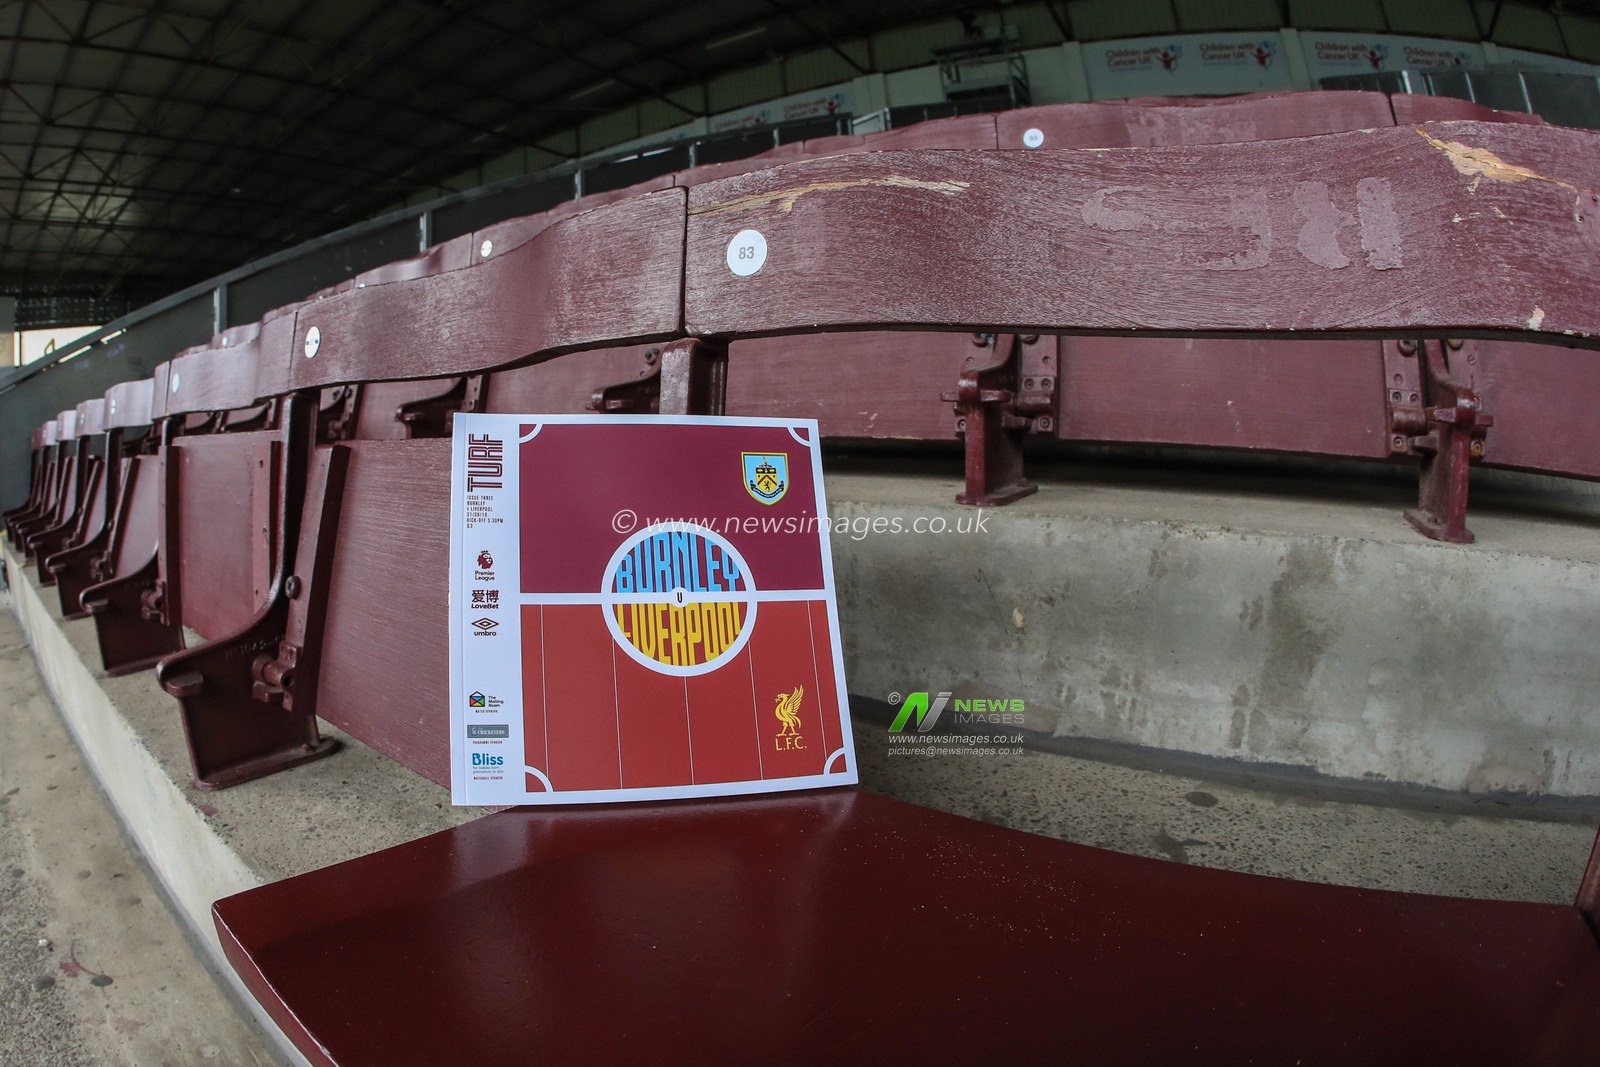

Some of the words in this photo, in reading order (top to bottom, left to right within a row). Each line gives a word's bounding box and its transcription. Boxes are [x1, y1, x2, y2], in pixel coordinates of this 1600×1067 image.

[738, 246, 755, 260] 83
[467, 433, 503, 493] TURF
[615, 531, 741, 594] BURNLEY
[471, 589, 500, 603] 爱博
[616, 602, 743, 667] LIVERPOOL
[775, 736, 808, 751] L.F.C.
[472, 753, 504, 766] Bliss
